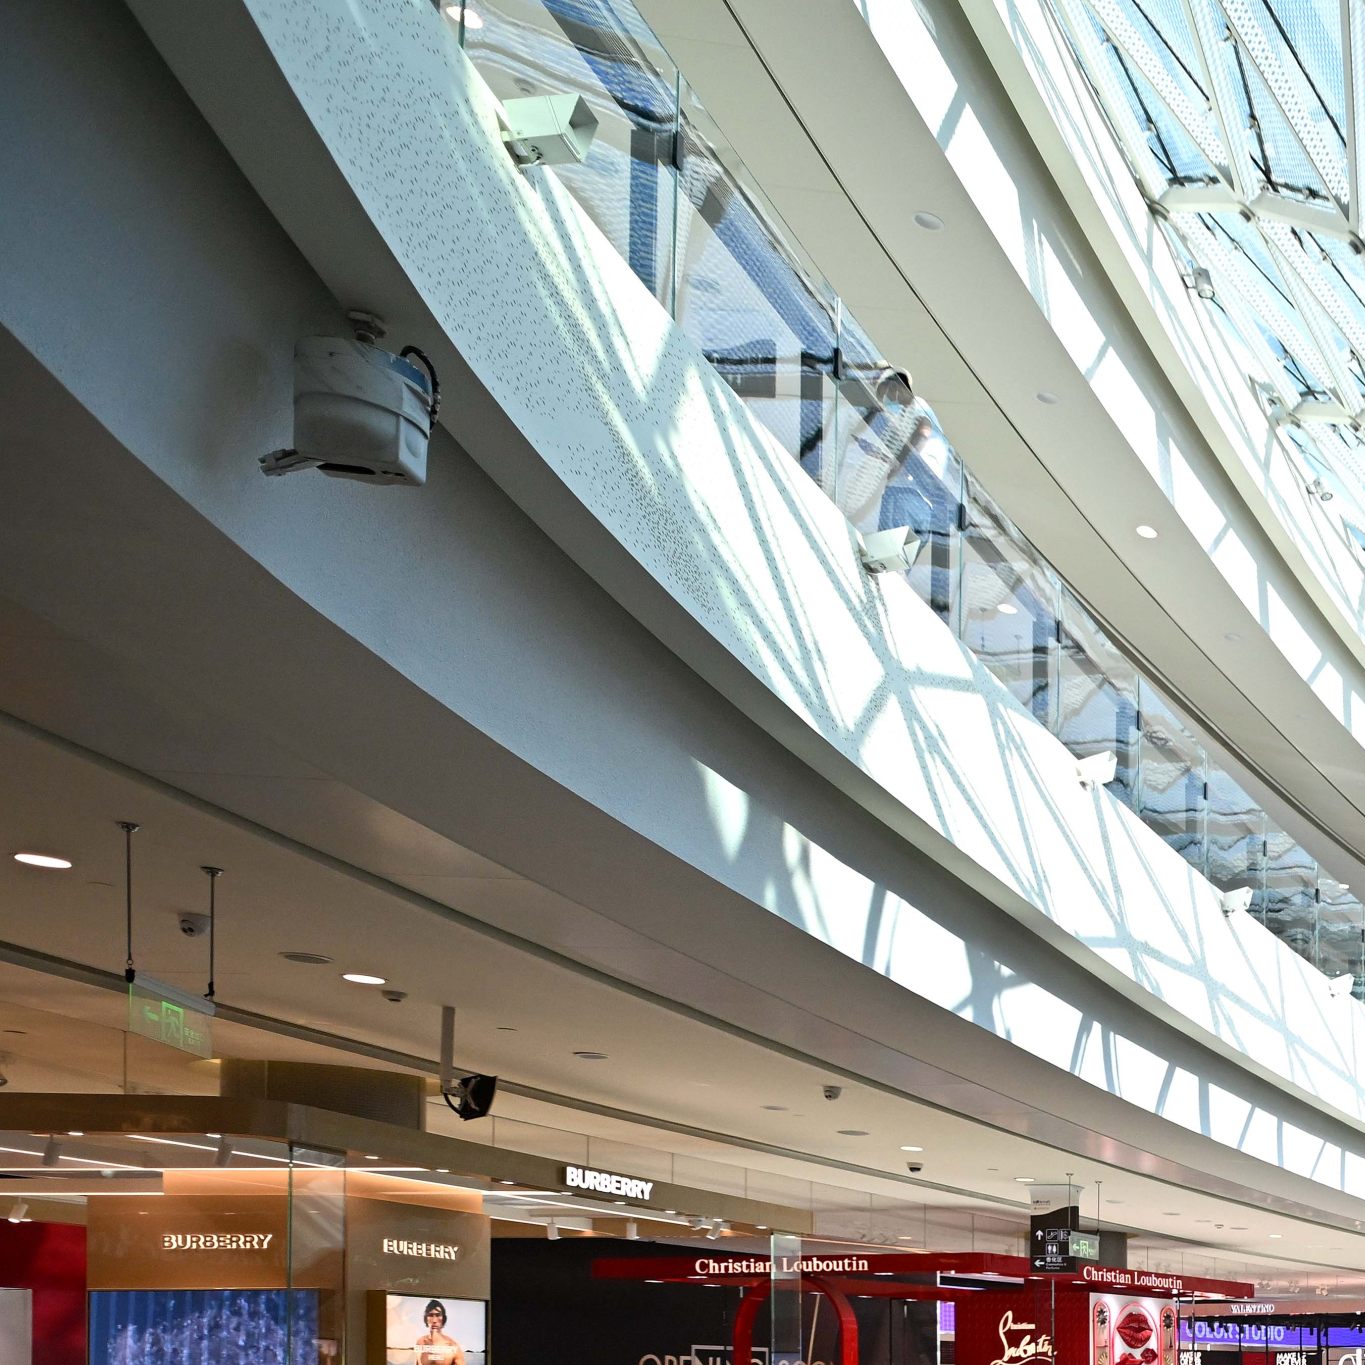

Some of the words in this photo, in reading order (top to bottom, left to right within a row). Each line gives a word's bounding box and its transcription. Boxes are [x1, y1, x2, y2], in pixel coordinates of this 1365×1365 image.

[566, 1166, 653, 1200] BURBERRY
[162, 1234, 272, 1250] BURBERRY
[383, 1238, 459, 1260] BURBERRY
[695, 1258, 776, 1274] Christian
[782, 1258, 869, 1273] Louboutin
[1083, 1266, 1132, 1284] Christian
[1134, 1272, 1183, 1290] Louboutin
